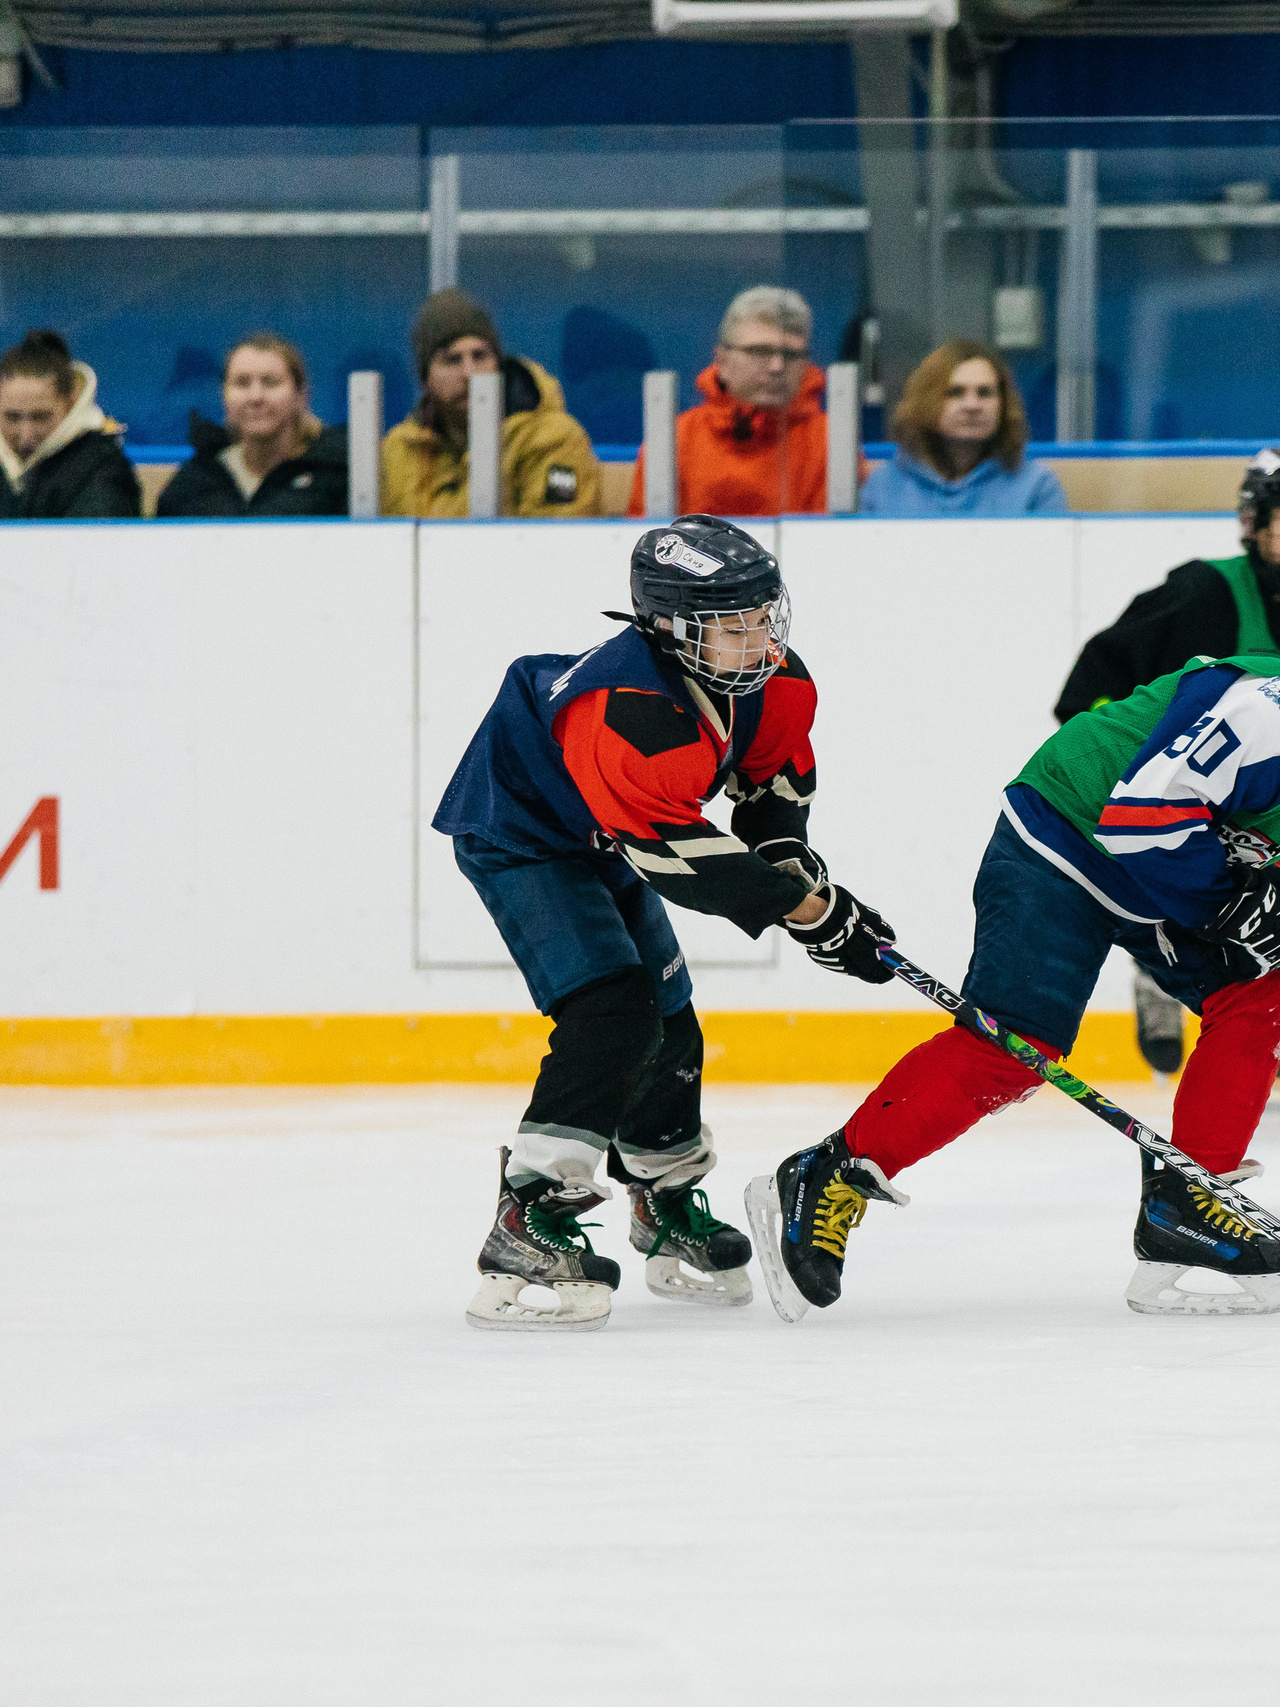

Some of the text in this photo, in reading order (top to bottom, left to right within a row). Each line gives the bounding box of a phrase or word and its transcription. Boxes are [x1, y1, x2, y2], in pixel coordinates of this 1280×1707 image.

[893, 960, 967, 1011] ZAG
[794, 1182, 806, 1222] BAUER
[1175, 1224, 1219, 1248] BAUER
